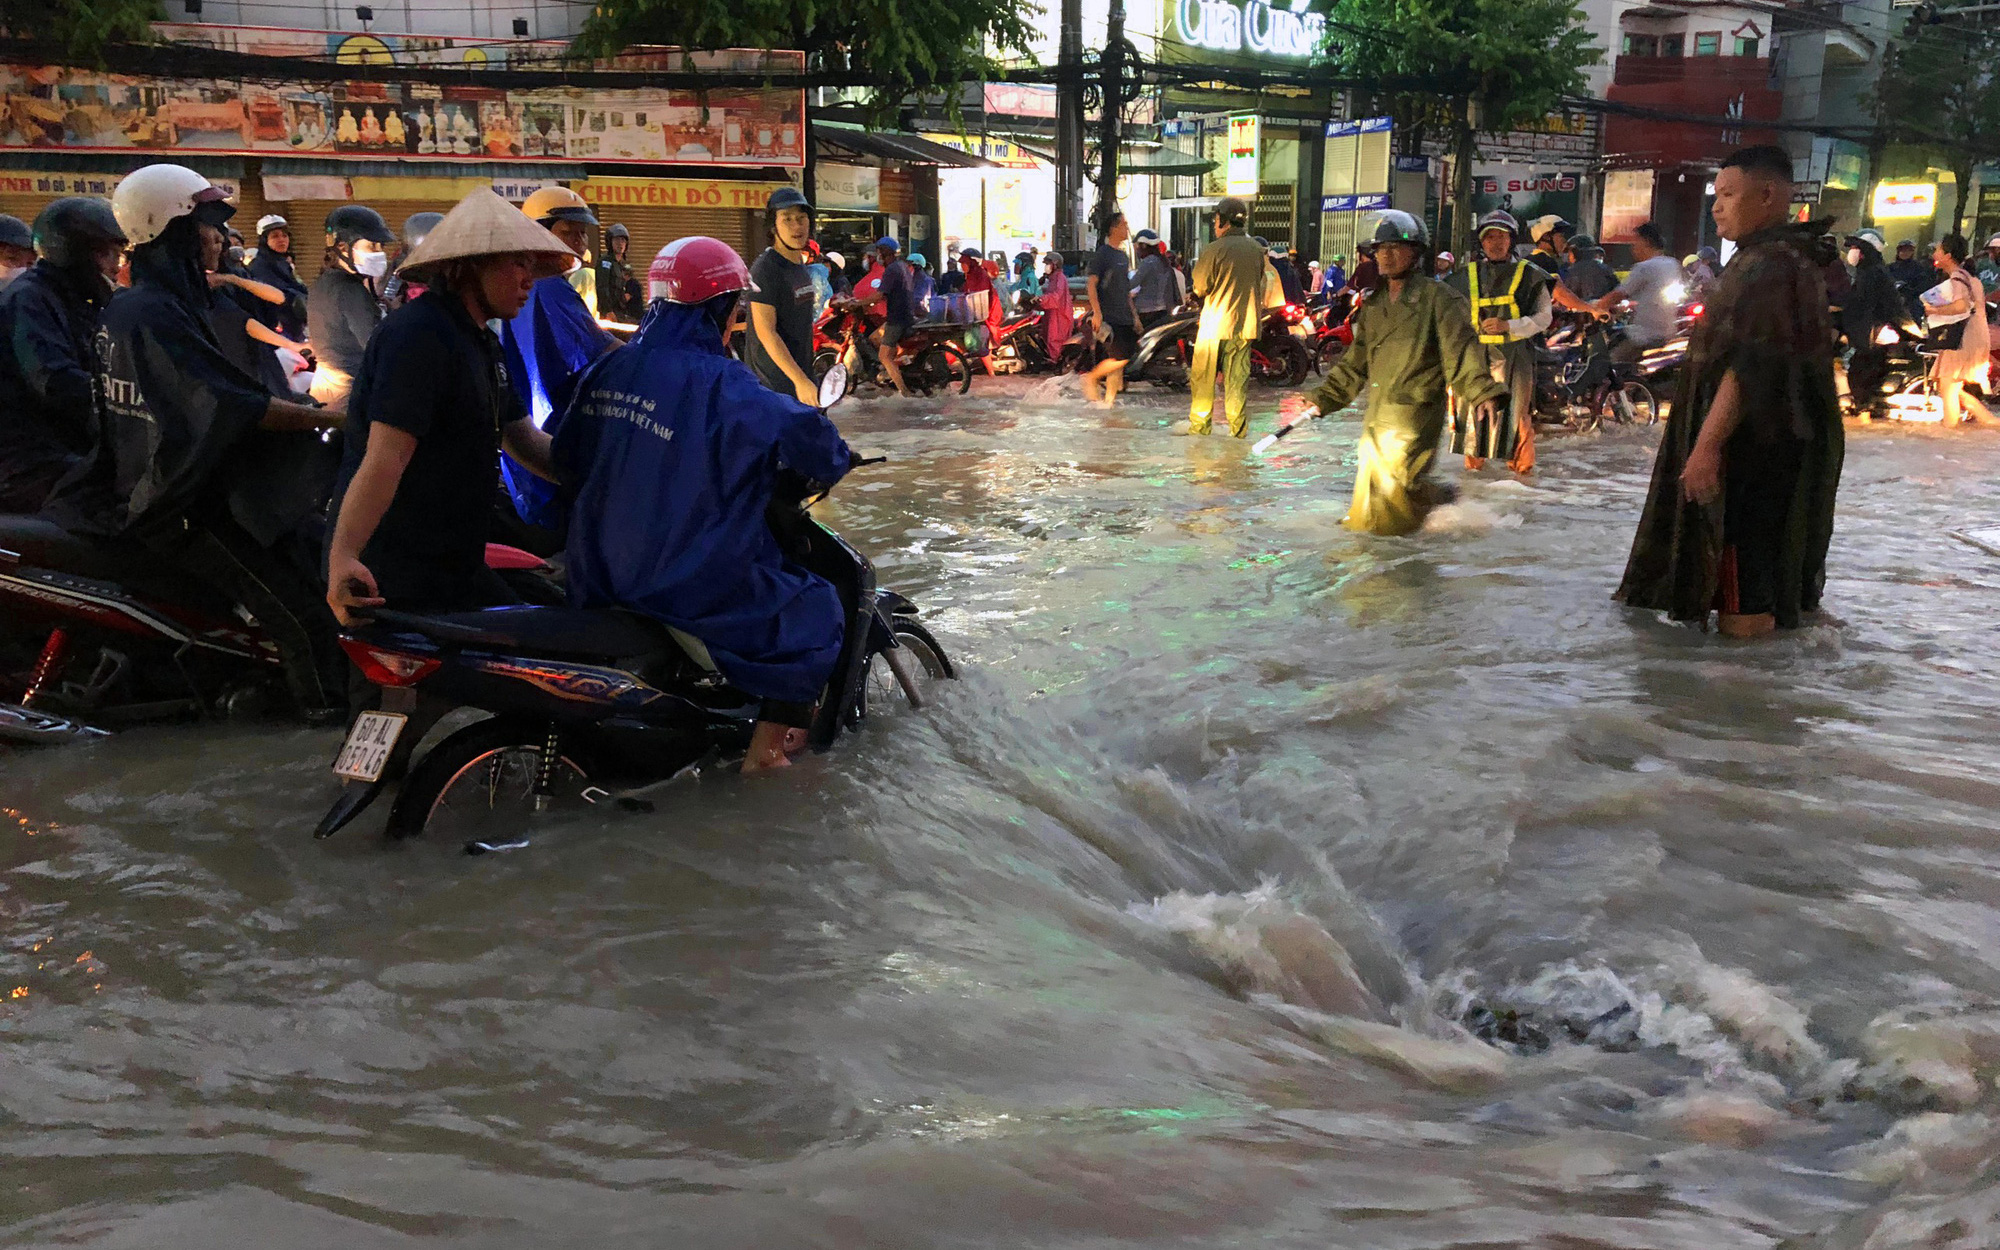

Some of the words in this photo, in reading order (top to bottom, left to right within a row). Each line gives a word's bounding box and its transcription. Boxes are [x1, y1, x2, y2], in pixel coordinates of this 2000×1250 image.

[579, 183, 677, 205] CHUYÊN
[686, 183, 722, 206] ĐỒ
[1484, 180, 1498, 194] 5
[1507, 177, 1575, 193] SUNG
[630, 409, 653, 430] VIỆT
[652, 421, 675, 441] NAM
